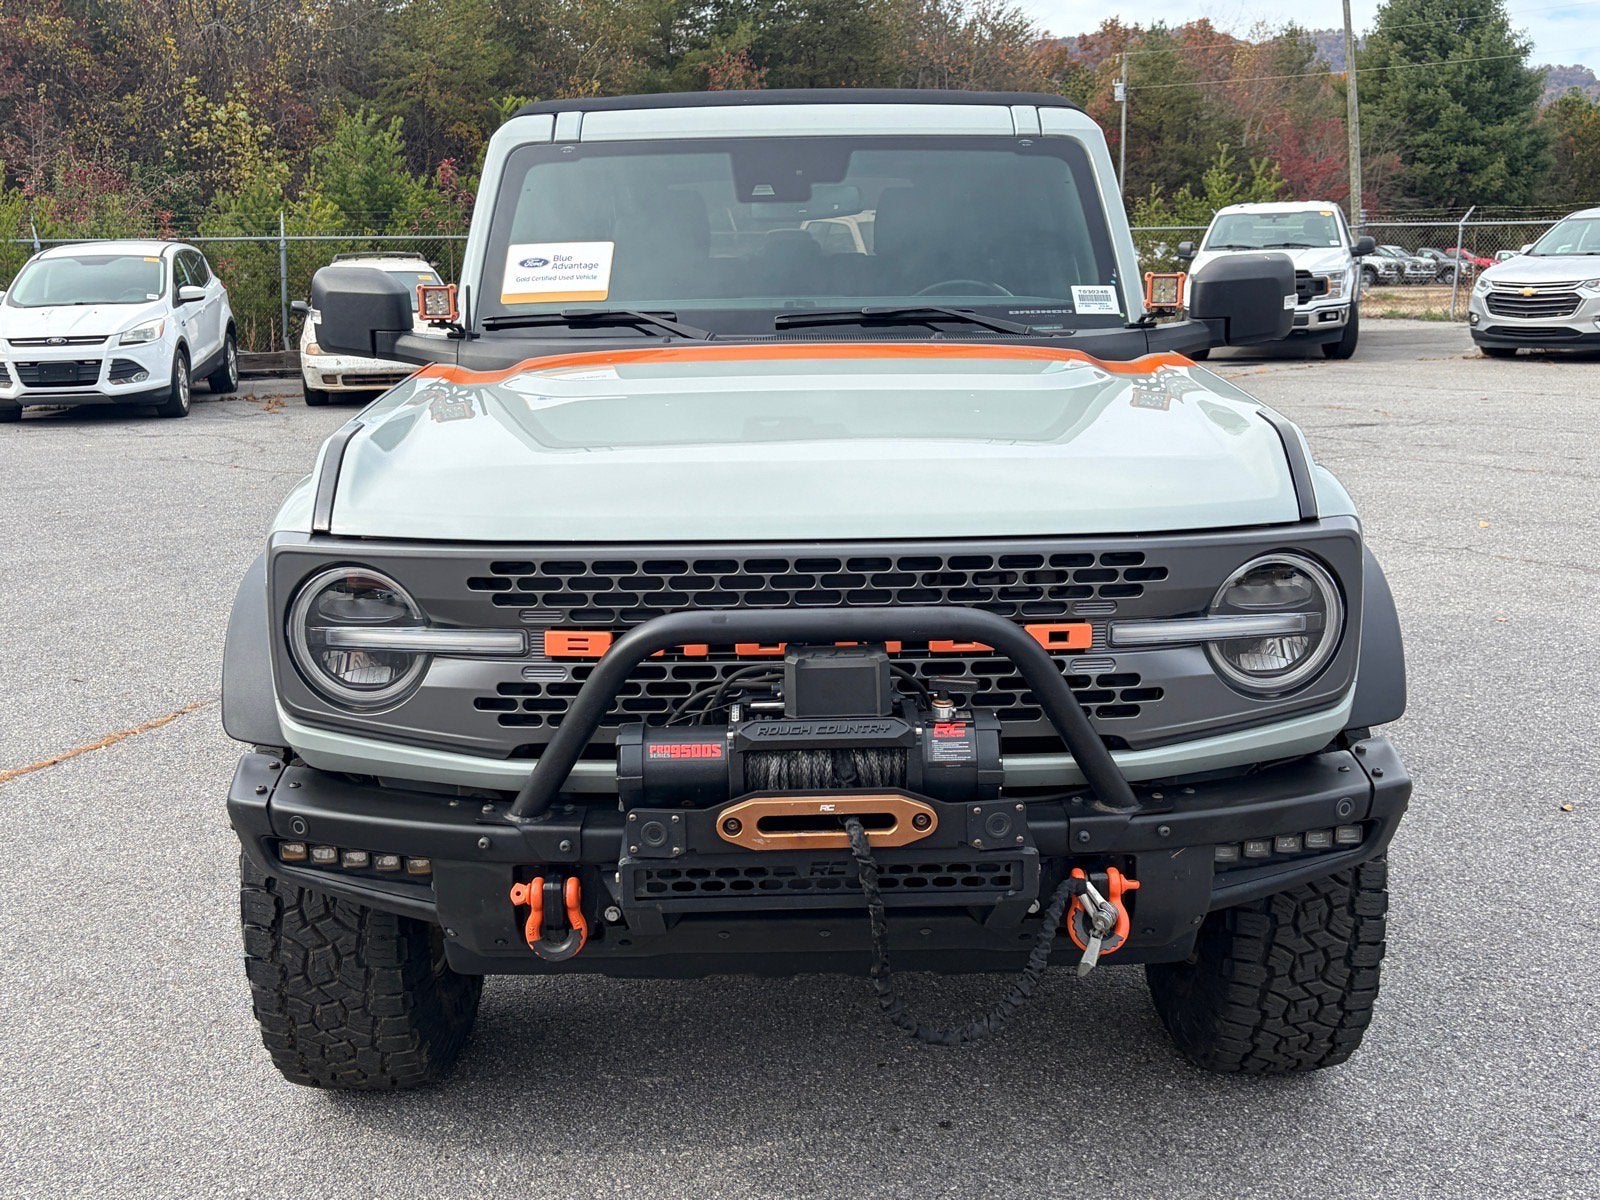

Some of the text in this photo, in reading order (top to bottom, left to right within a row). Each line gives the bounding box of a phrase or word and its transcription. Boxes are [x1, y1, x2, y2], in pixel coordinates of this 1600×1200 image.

[553, 254, 573, 262] Blue
[551, 261, 600, 270] Advantage
[757, 723, 892, 737] ROUGH COUNTRY
[649, 743, 722, 759] PRO 9500S
[819, 804, 836, 812] RC
[809, 861, 849, 876] RC
